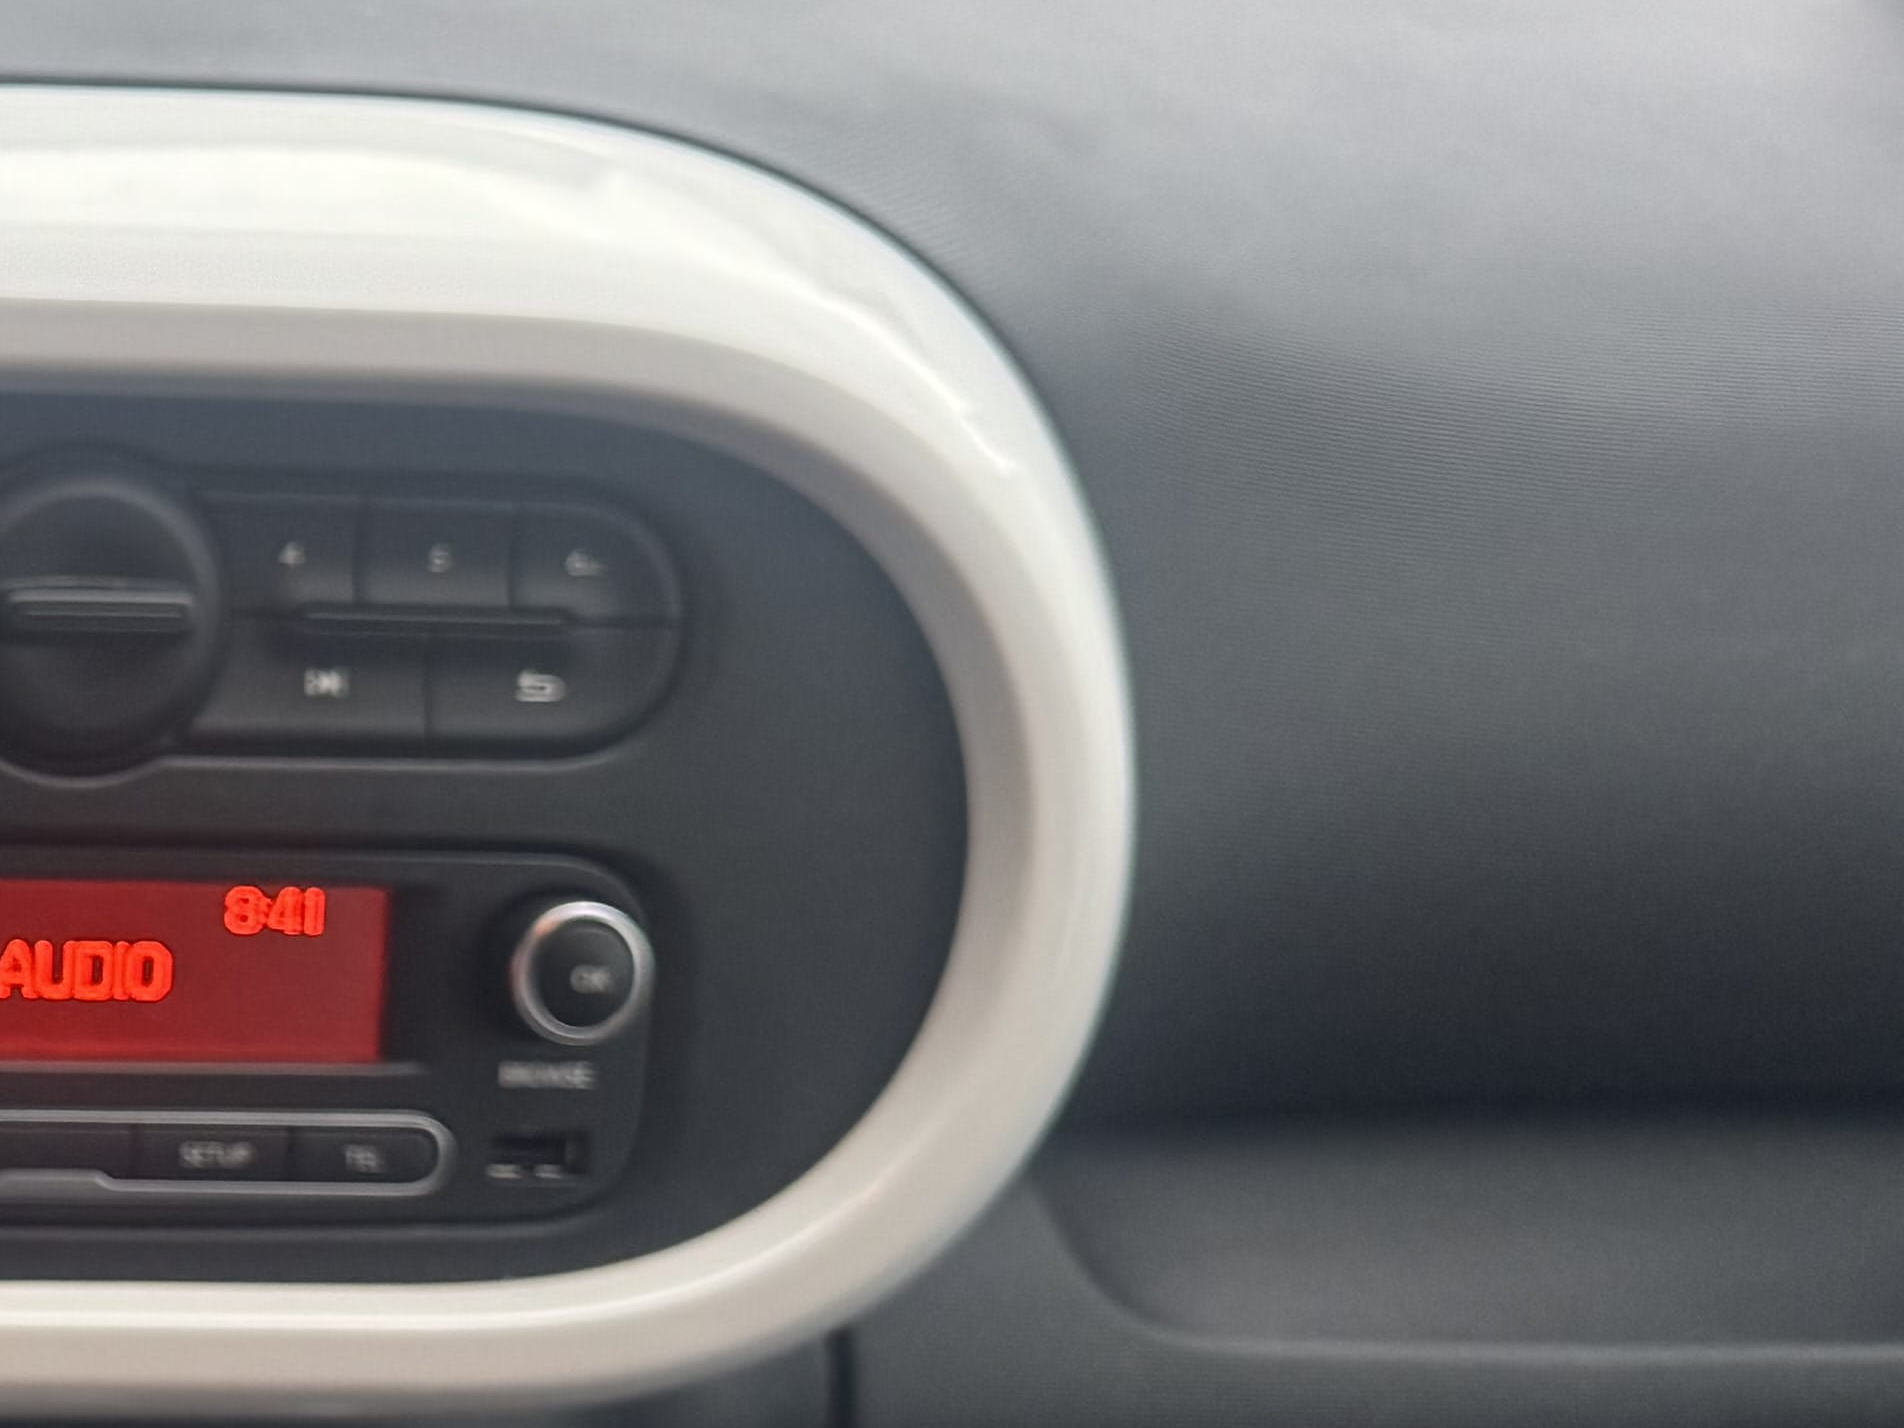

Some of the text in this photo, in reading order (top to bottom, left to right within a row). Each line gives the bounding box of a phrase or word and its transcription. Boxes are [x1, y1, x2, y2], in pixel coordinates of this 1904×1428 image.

[278, 541, 305, 565] 4
[223, 886, 326, 935] 8:41
[570, 965, 611, 993] OK
